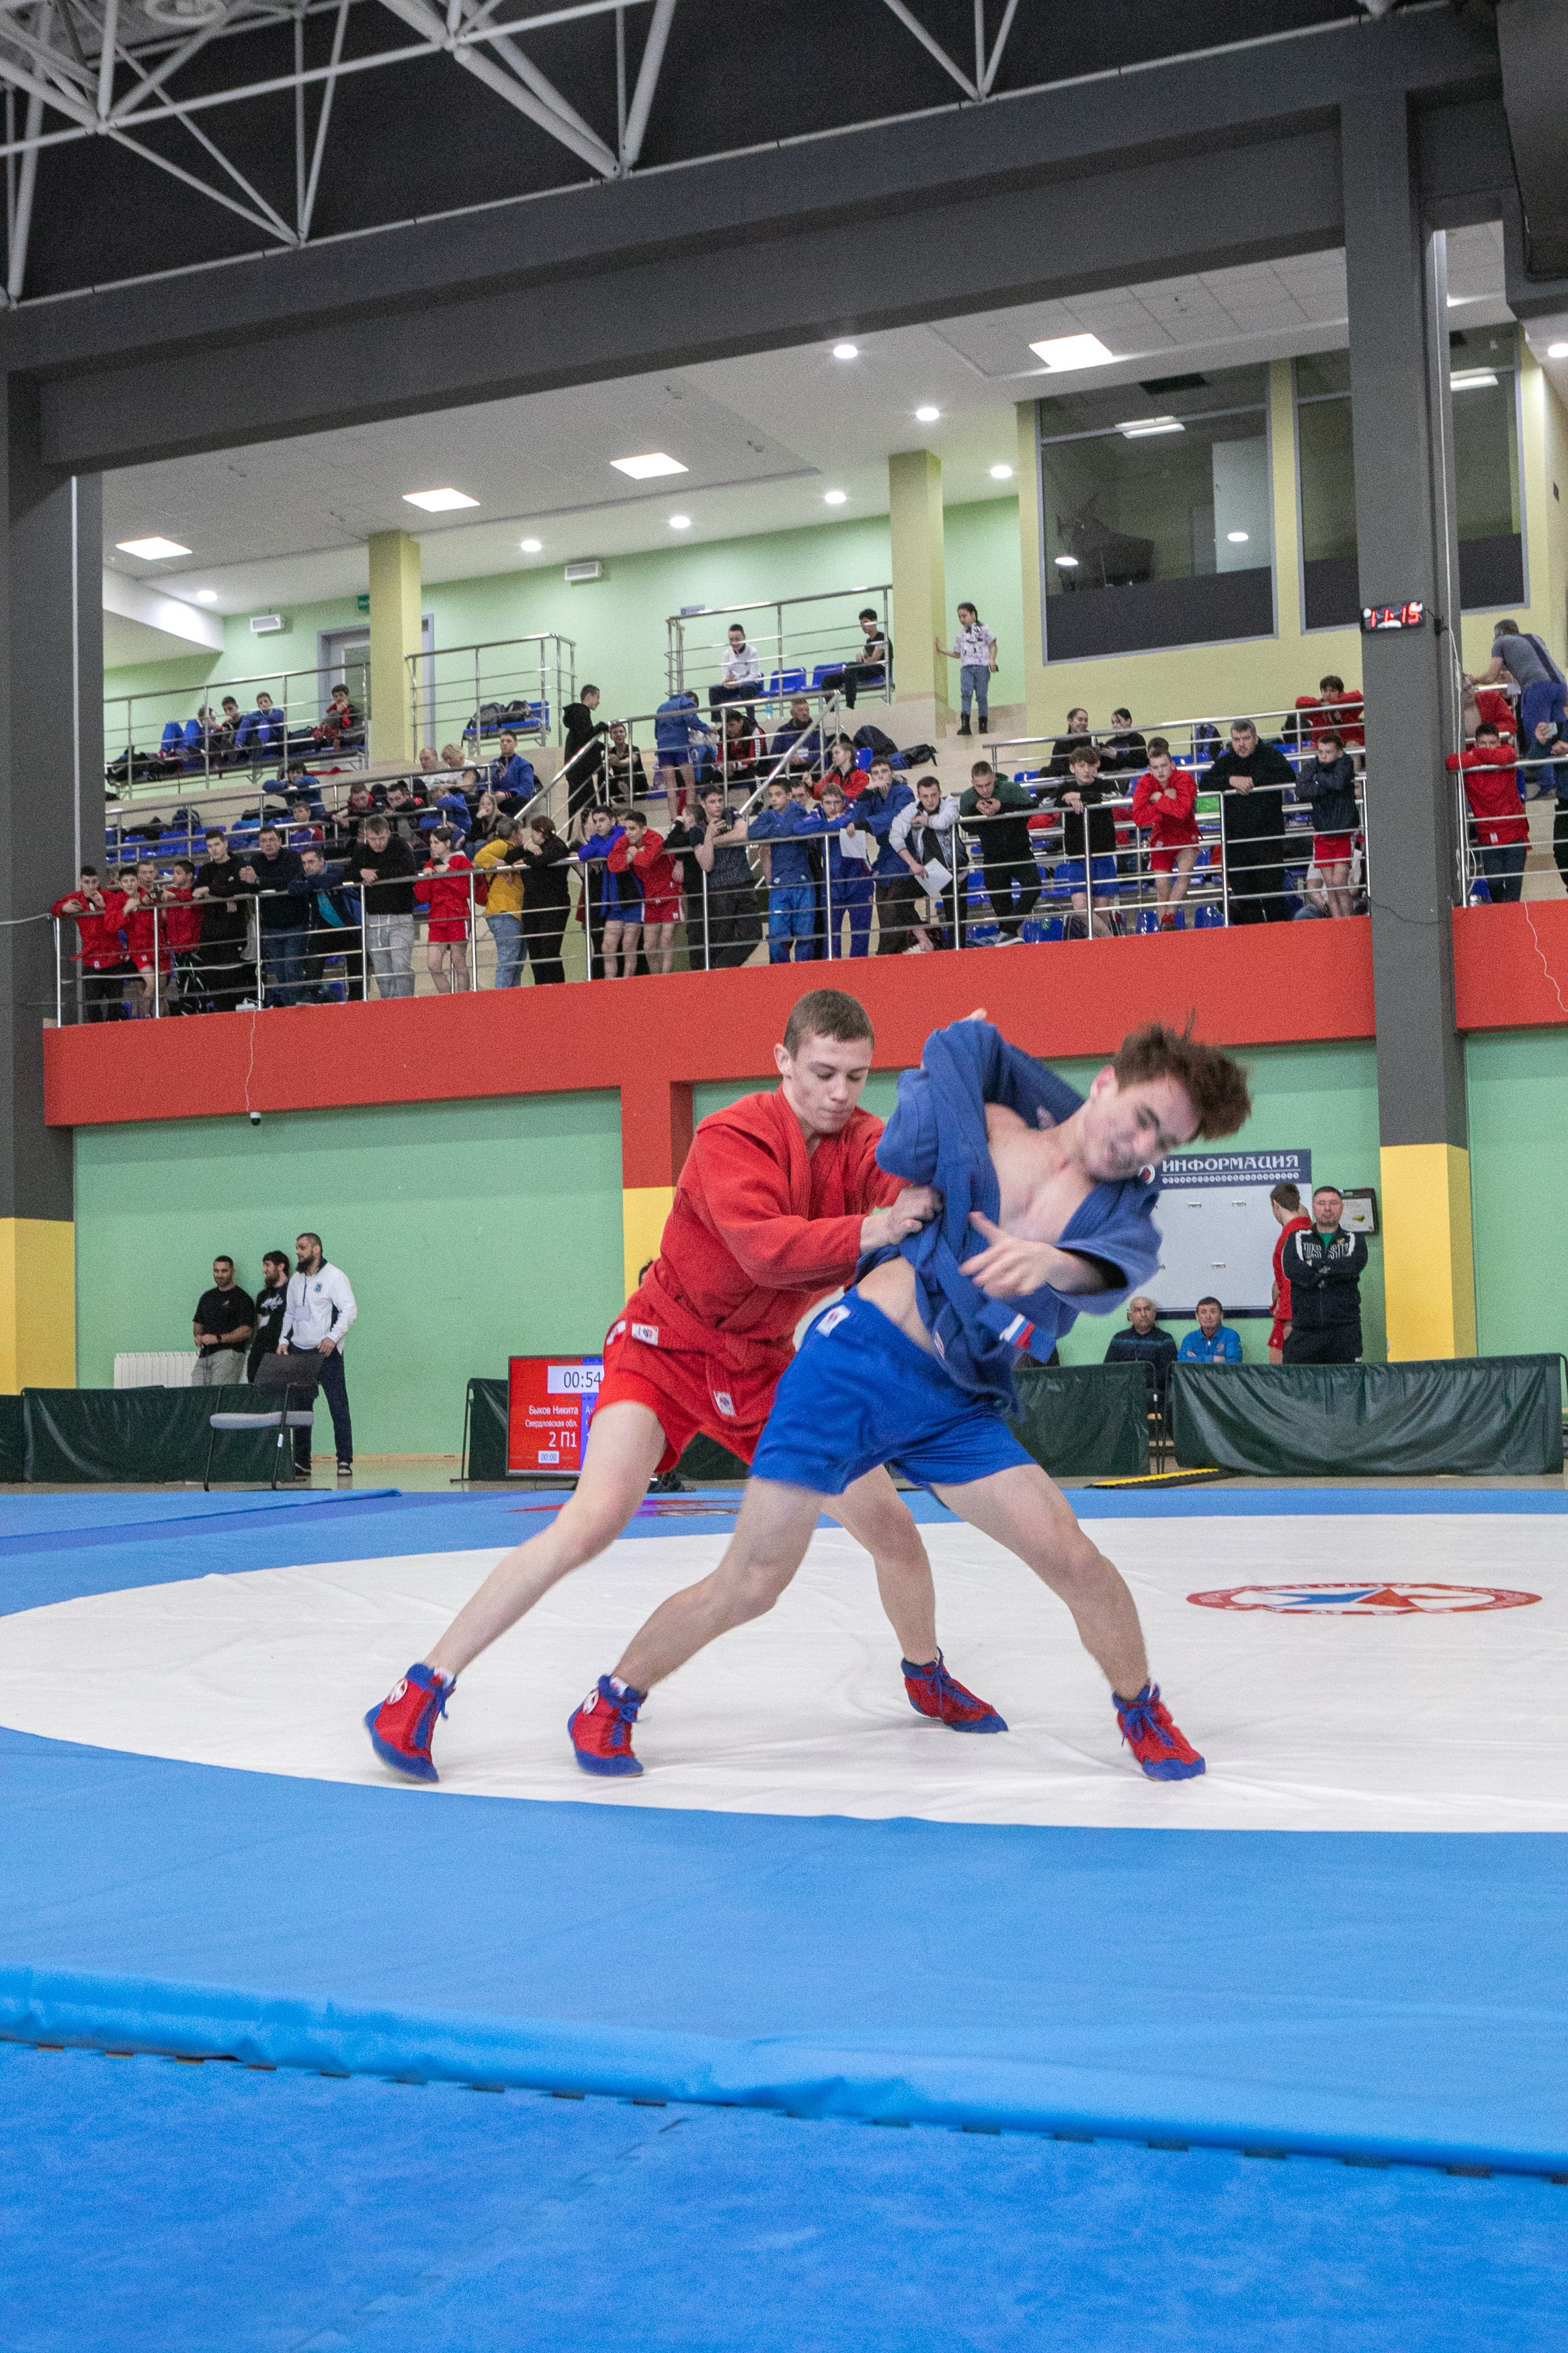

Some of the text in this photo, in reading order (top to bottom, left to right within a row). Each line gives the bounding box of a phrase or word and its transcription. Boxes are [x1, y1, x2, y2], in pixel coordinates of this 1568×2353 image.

[1162, 1154, 1299, 1172] ИНФОРМАЦИЯ
[563, 1371, 602, 1388] 00:54
[528, 1405, 551, 1415] Быков
[552, 1405, 579, 1415] Никита
[548, 1431, 556, 1447] 2
[540, 1453, 557, 1462] 00:00
